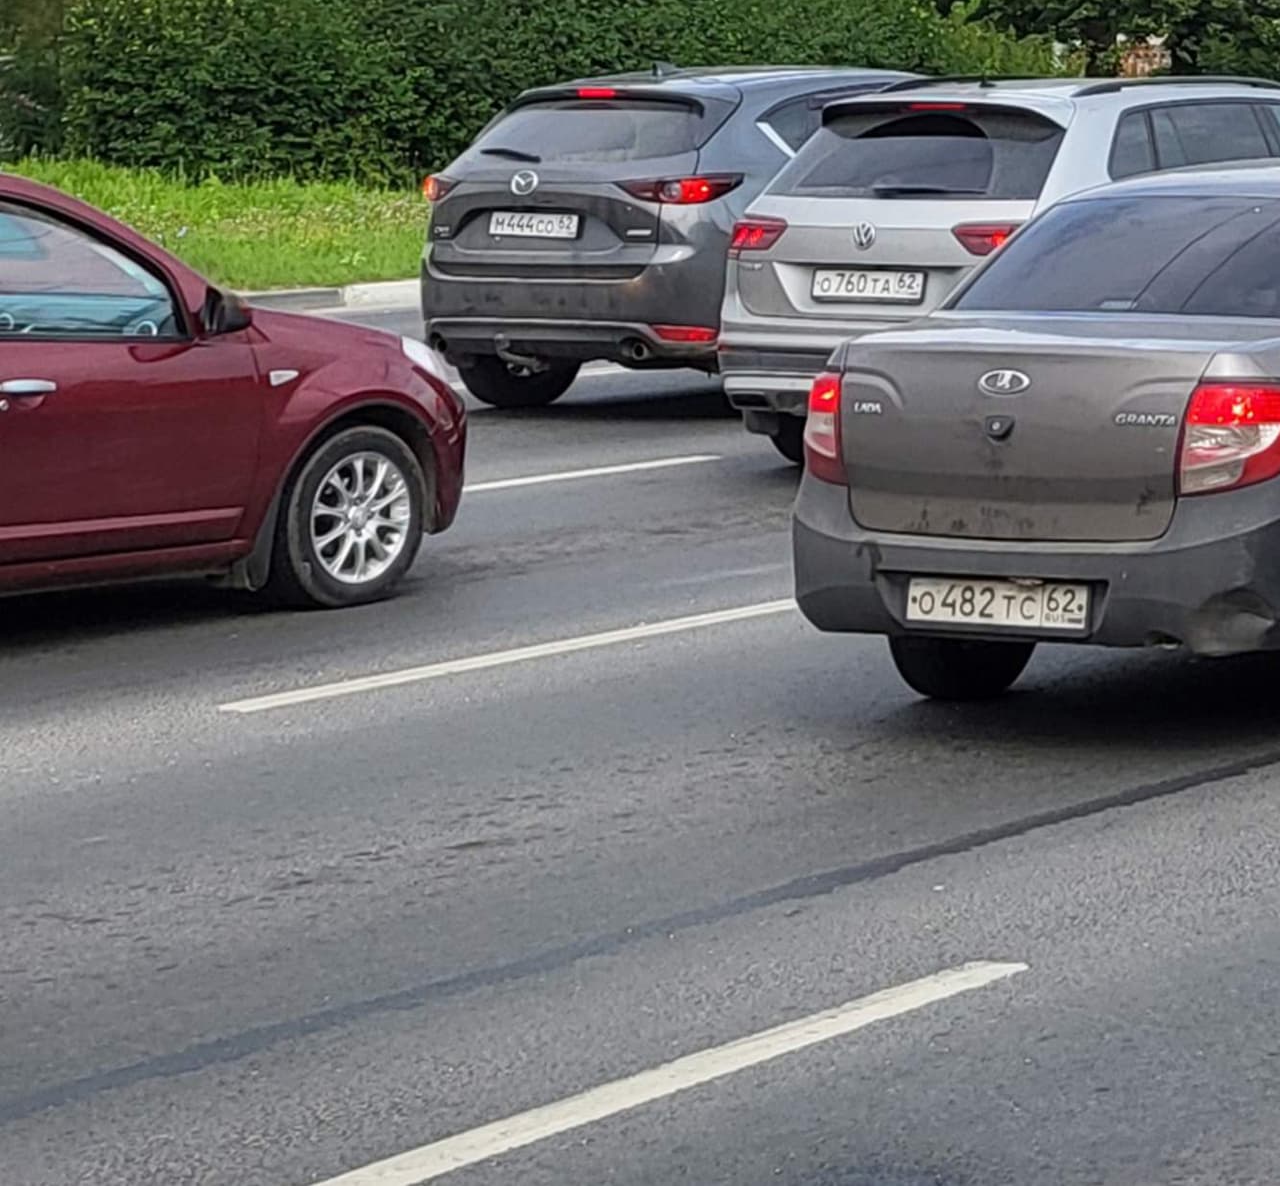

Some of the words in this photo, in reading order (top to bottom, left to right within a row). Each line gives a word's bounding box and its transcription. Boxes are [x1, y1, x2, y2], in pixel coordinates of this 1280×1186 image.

[897, 273, 917, 290] 62
[854, 402, 882, 414] LADA
[1115, 413, 1176, 425] GRANTA
[918, 584, 1037, 620] О482ТС
[1046, 587, 1076, 613] 62
